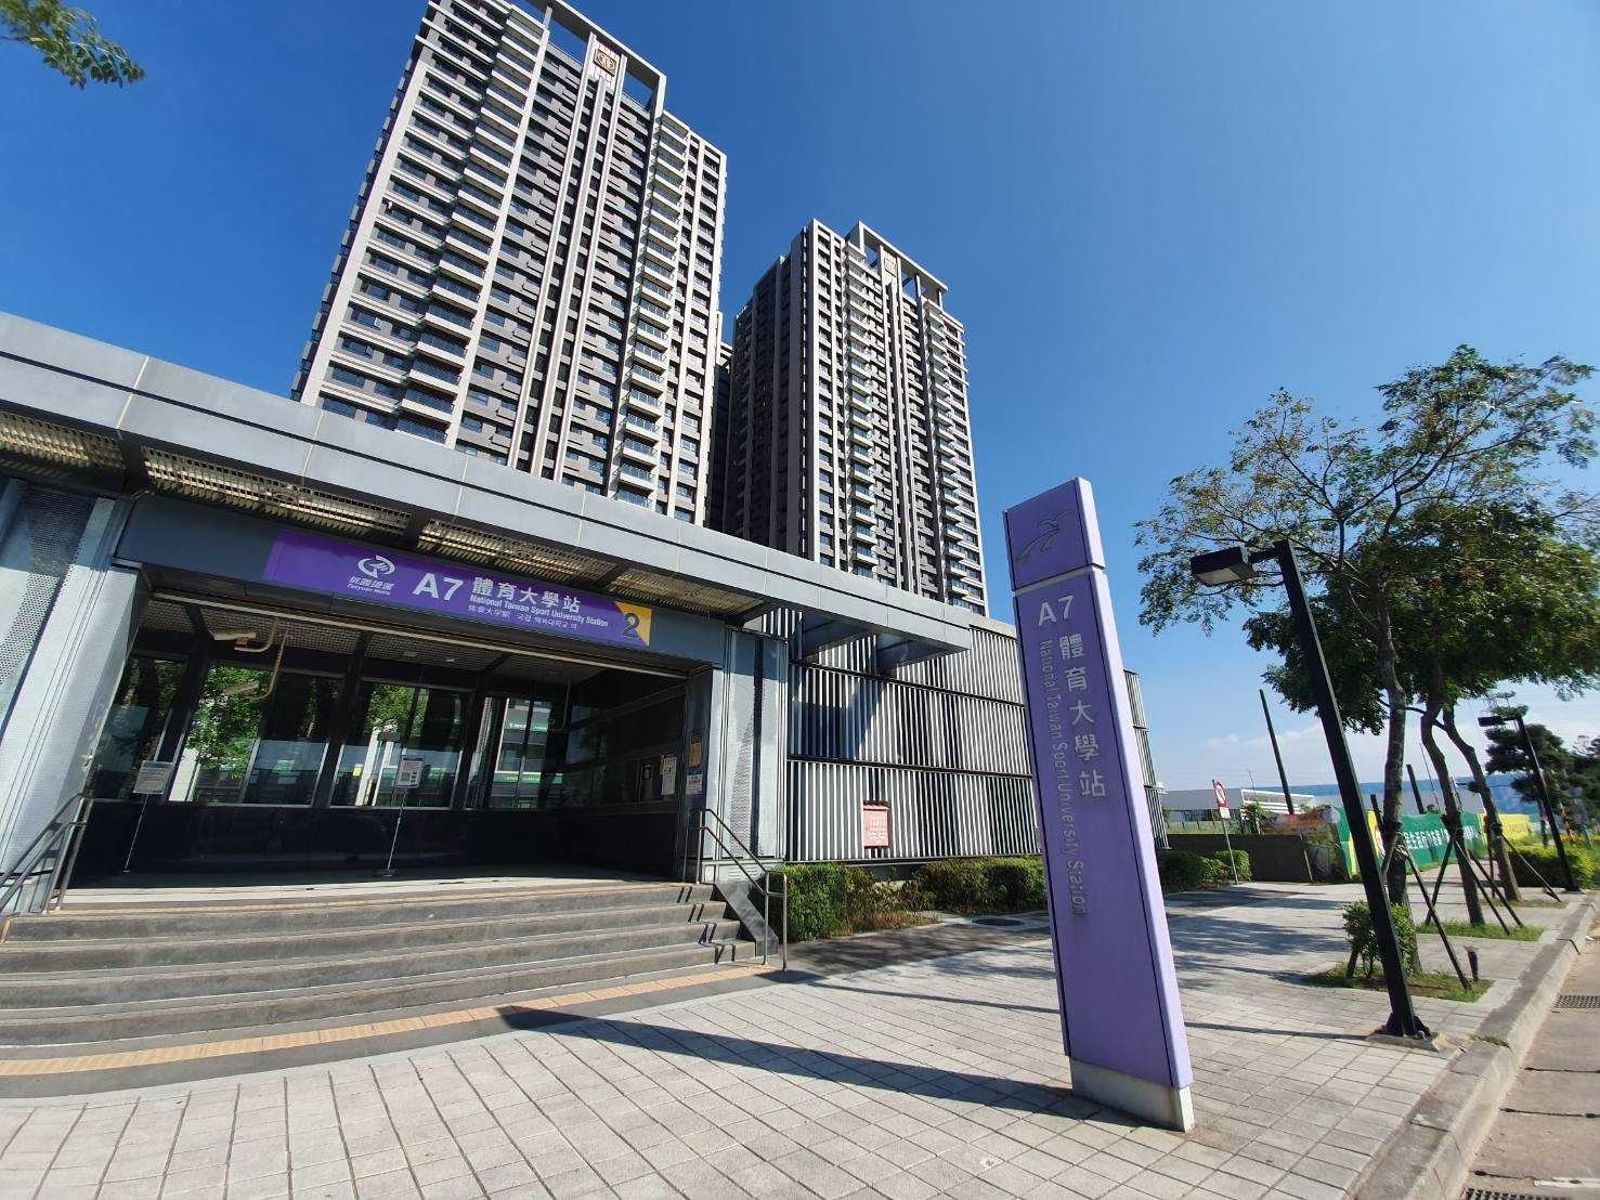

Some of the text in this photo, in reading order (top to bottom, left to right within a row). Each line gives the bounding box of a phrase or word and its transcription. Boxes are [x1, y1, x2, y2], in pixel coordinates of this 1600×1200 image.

[412, 573, 464, 601] A7
[472, 577, 581, 613] 體育大學站
[469, 594, 608, 627] National Taiwan Sport University Station
[623, 613, 640, 638] 2
[1038, 595, 1073, 626] A7
[1059, 633, 1106, 797] 體育大學站
[1039, 640, 1088, 915] National Taiwan Sport University Station
